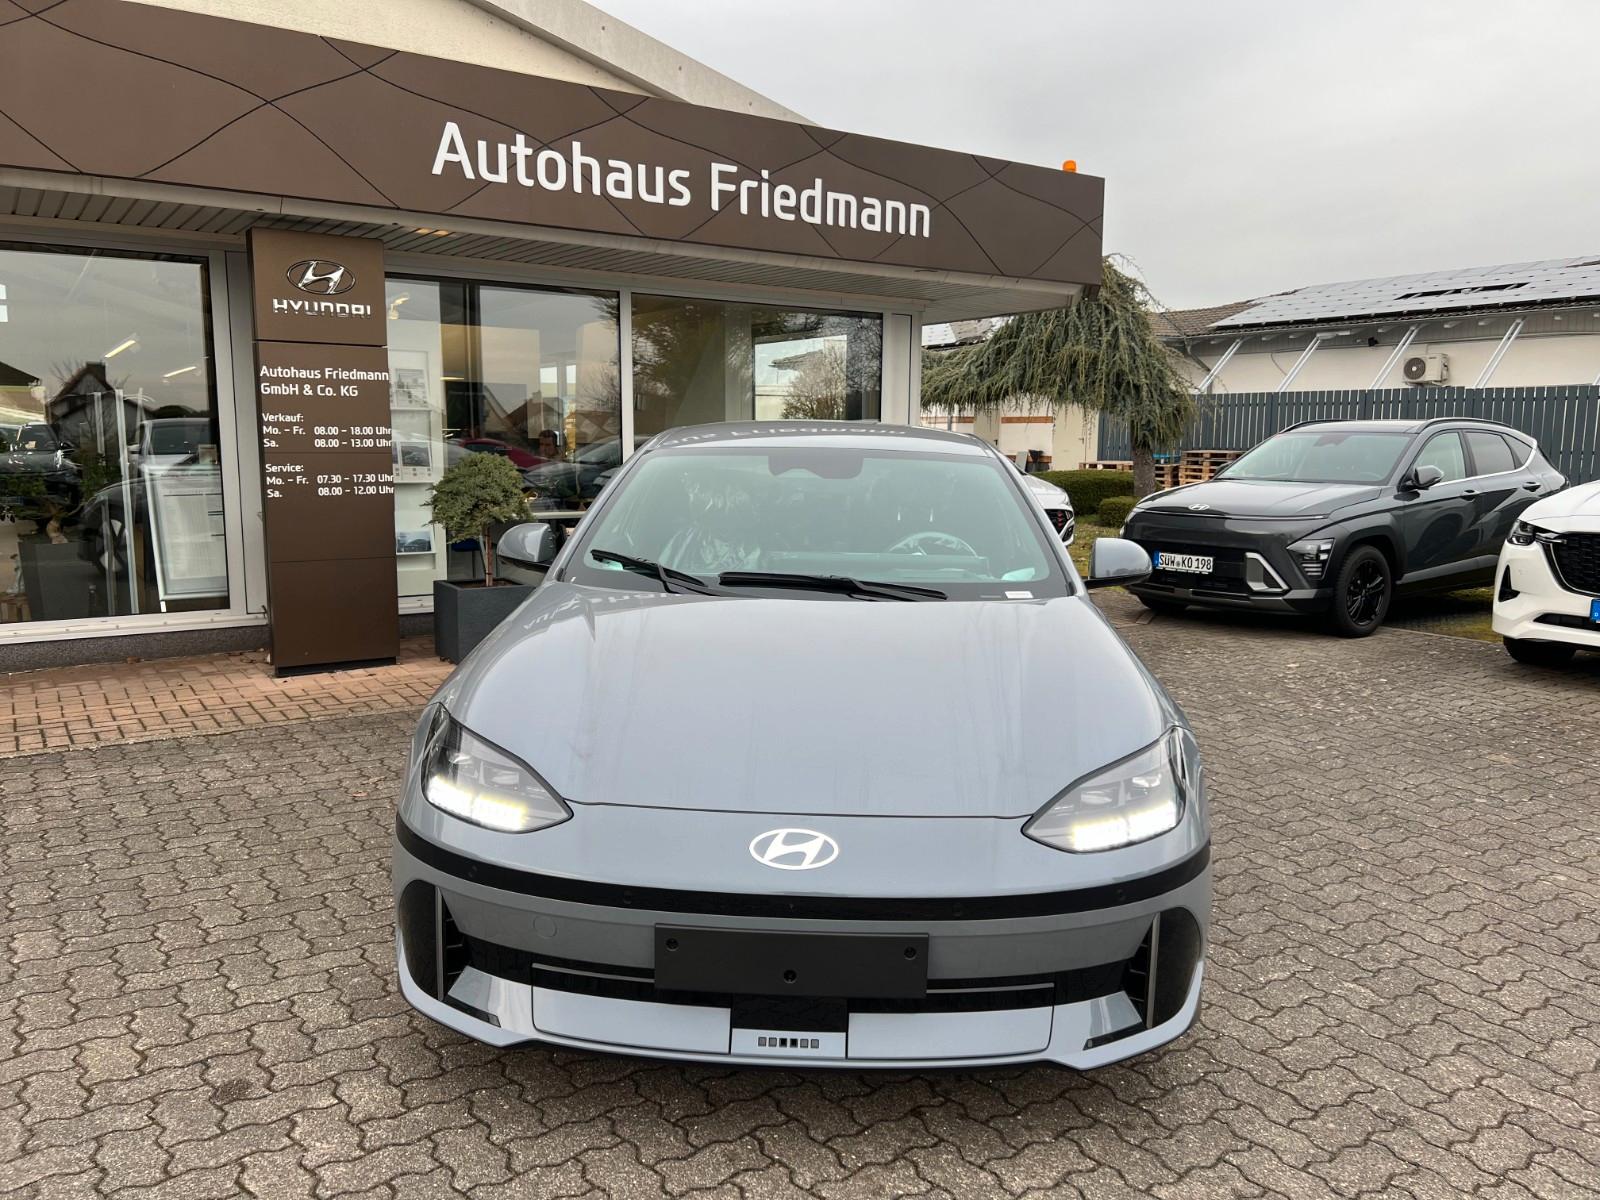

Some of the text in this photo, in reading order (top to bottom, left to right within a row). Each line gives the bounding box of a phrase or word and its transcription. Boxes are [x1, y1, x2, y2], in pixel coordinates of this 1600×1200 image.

[431, 121, 931, 238] Autohaus Friedmann
[272, 298, 372, 317] HYUNDAI
[259, 365, 389, 381] Autohaus Friedmann
[260, 383, 359, 397] GmbH & Co. KG
[262, 413, 304, 422] Verkauf:
[262, 425, 281, 435] Mo.
[293, 426, 306, 435] Fr.
[314, 426, 339, 435] 08.00
[350, 426, 374, 435] 18.00
[375, 426, 392, 435] Uhr
[263, 438, 279, 448] Sa.
[314, 438, 339, 448] 08.00
[351, 438, 374, 448] 13.00
[376, 438, 392, 447] Uhr
[265, 463, 304, 473] Service:
[266, 476, 285, 485] Mo.
[296, 476, 309, 485] Fr.
[317, 474, 342, 484] 07.30
[352, 474, 376, 483] 17.30
[378, 474, 394, 482] Uhr
[267, 489, 283, 498] Sa.
[318, 487, 343, 496] 08.00
[353, 486, 377, 495] 12.00
[1195, 558, 1212, 570] 198
